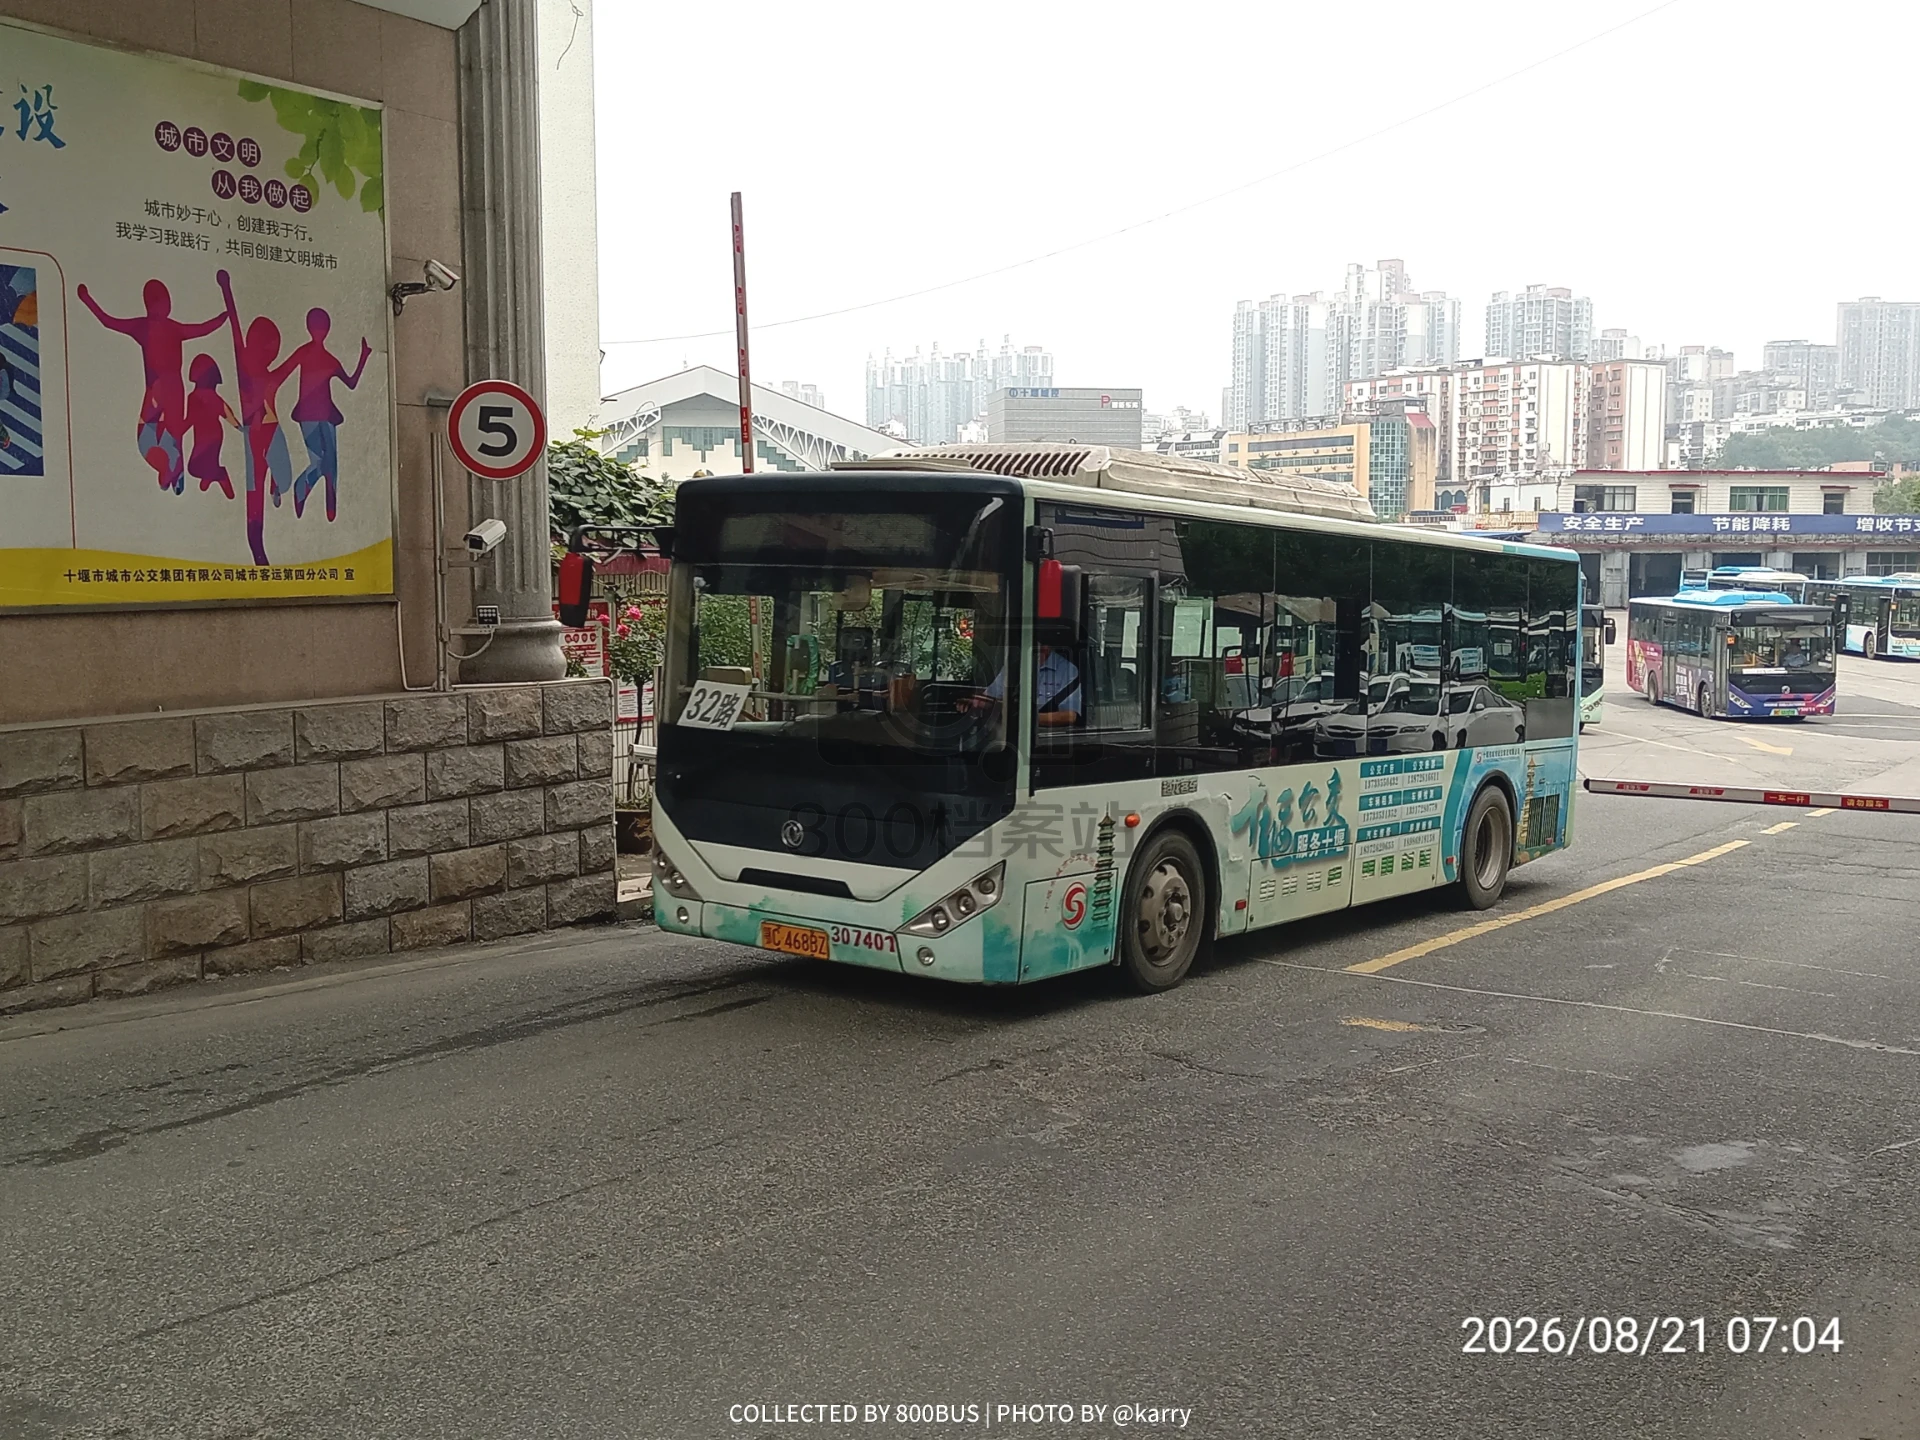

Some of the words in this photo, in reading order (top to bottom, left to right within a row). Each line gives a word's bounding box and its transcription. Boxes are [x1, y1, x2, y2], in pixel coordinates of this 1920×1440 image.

[0, 84, 66, 148] 设
[158, 124, 258, 164] 城市文明
[214, 172, 309, 210] 从我做起
[116, 221, 338, 270] 我学习我践行，共同创建文明城市
[477, 405, 518, 457] 5
[1562, 516, 1644, 531] 安全生产
[1712, 516, 1790, 531] 节能降耗
[64, 568, 339, 583] 十堰市城市公交集团有限公司城市客运第四分公司
[344, 569, 354, 581] 宣
[687, 688, 740, 728] 32路
[1370, 764, 1394, 775] 公交广告
[1769, 794, 1805, 804] 一车一杆
[1846, 798, 1884, 808] 请勿跟车
[1296, 828, 1345, 859] 服务十堰
[831, 926, 896, 953] 307401
